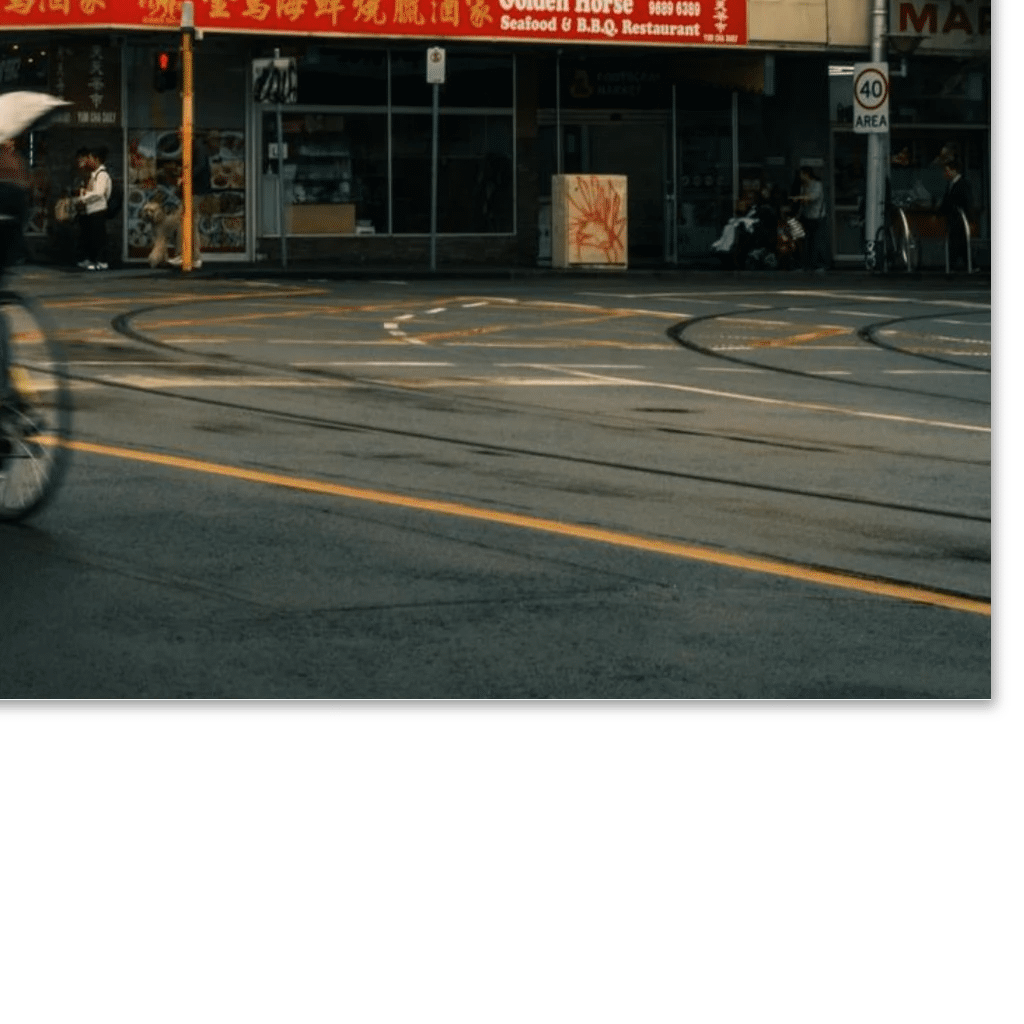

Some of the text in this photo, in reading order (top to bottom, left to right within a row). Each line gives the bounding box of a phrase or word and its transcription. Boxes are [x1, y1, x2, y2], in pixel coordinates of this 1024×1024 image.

[500, 14, 701, 37] Seafood & B.B.Q. Restaurant
[860, 80, 883, 98] 40
[856, 115, 887, 128] AREA
